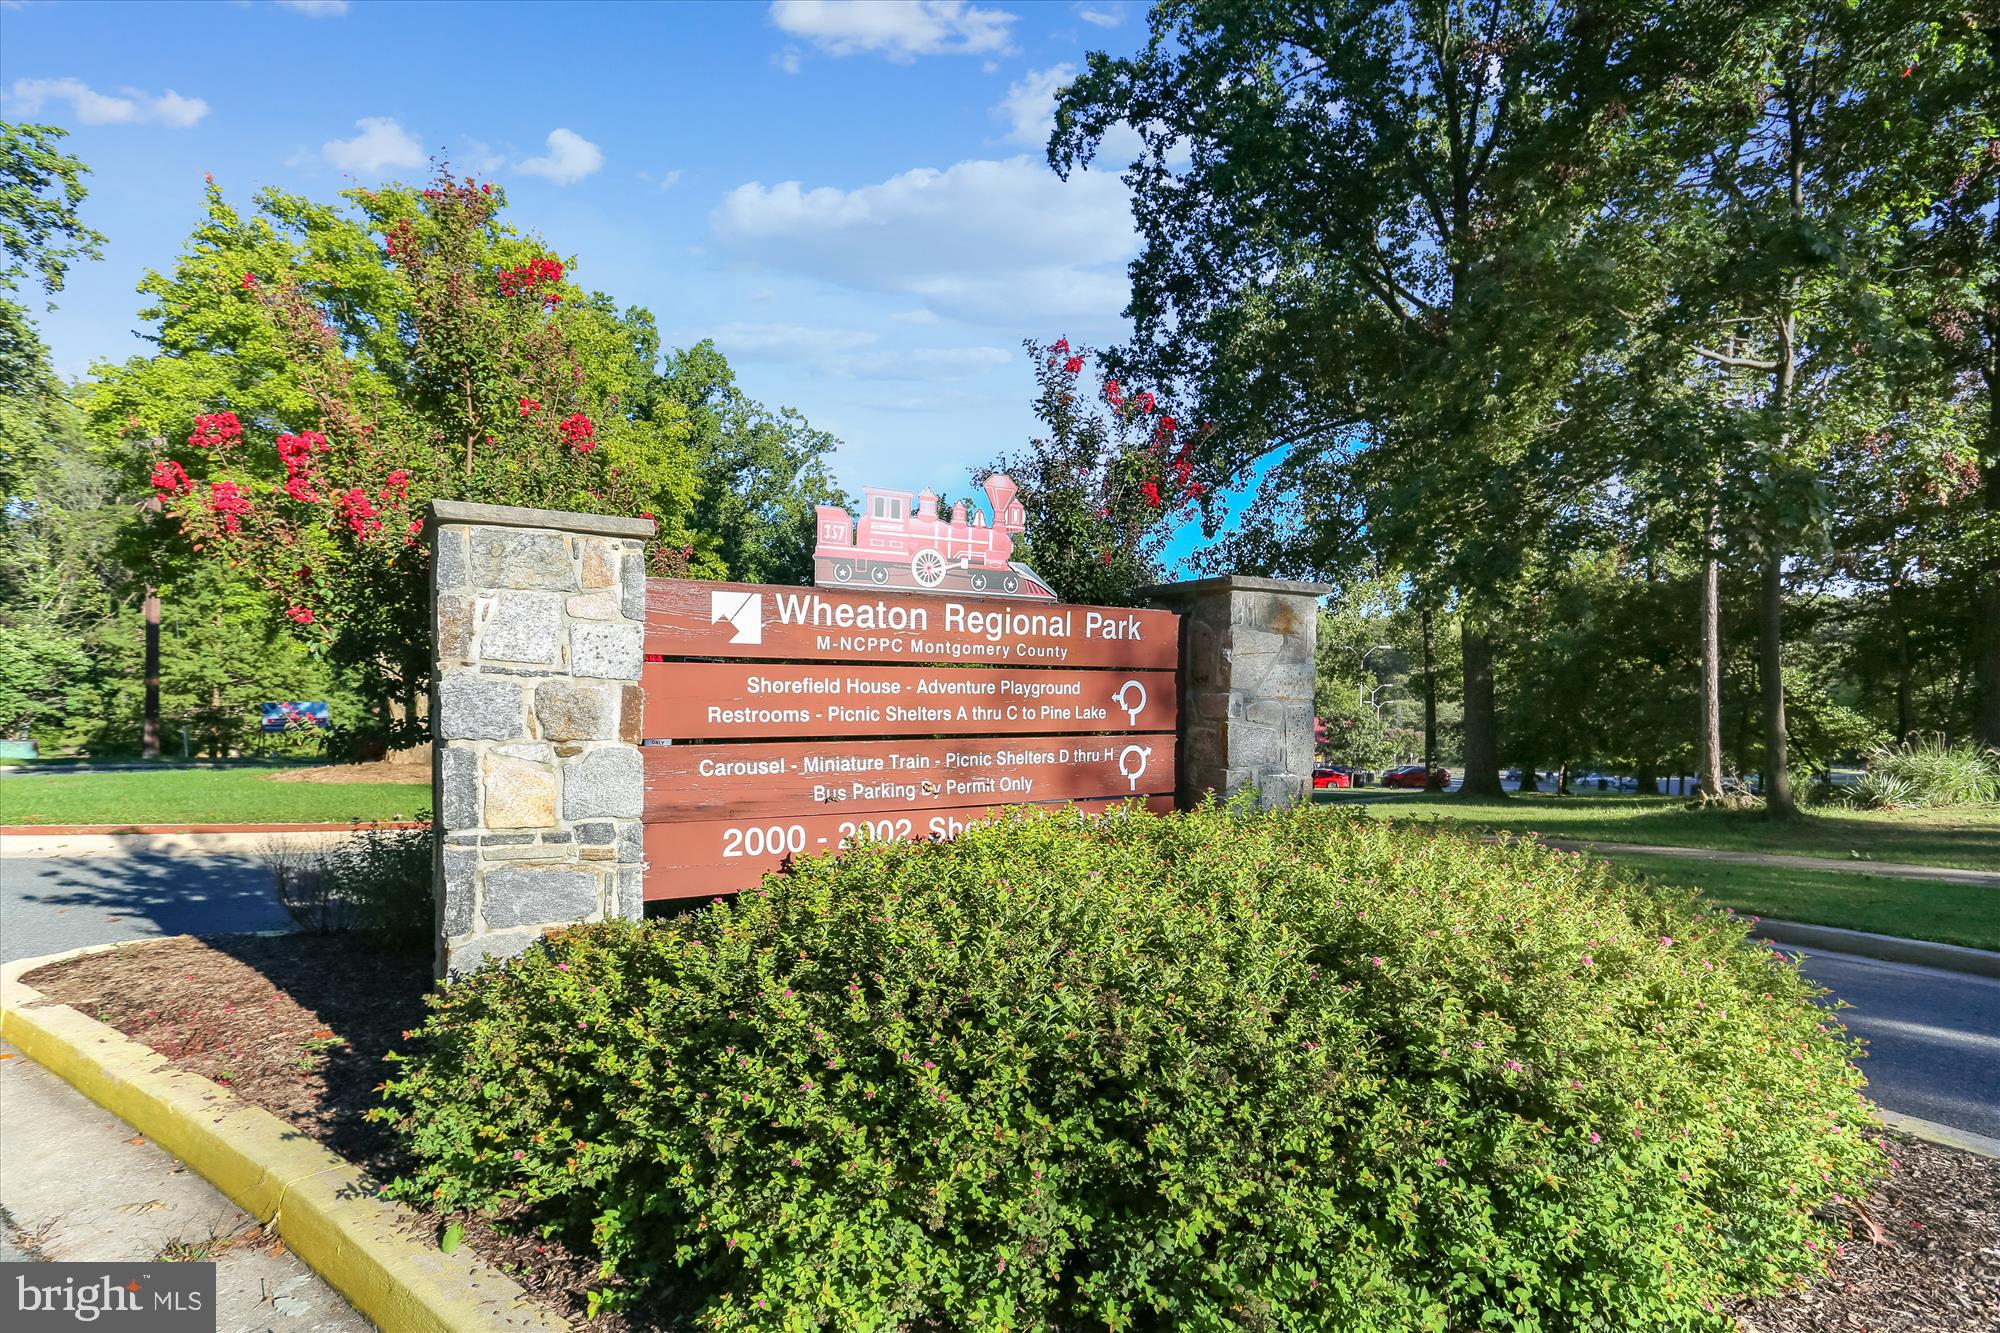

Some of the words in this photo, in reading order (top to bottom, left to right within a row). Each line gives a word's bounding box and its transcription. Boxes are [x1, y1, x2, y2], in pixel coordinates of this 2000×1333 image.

[775, 593, 928, 631] Wheaton
[945, 603, 1072, 641] Regional
[1086, 611, 1142, 641] Park
[816, 635, 903, 653] M-NCPPC
[910, 640, 1010, 659] Montgomery
[1016, 643, 1068, 661] County
[747, 676, 841, 694] Shorefield
[847, 678, 901, 694] House
[916, 679, 996, 695] Adventure
[1000, 680, 1081, 698] Playground
[708, 706, 810, 723] Restrooms
[828, 706, 880, 722] Picnic
[885, 706, 952, 721] Shelters
[956, 706, 968, 721] A
[972, 706, 1001, 721] thru
[1006, 706, 1018, 720] C
[1022, 707, 1036, 720] to
[1041, 706, 1071, 719] Pine
[1075, 706, 1107, 719] Lake
[699, 757, 785, 777] Carousel
[804, 755, 884, 773] Miniature
[889, 753, 930, 769] Train
[946, 752, 992, 767] Picnic
[996, 751, 1055, 765] Shelters
[1060, 749, 1069, 763] D
[1073, 749, 1100, 762] thru
[1104, 747, 1114, 761] H
[813, 784, 847, 802] Bus
[852, 782, 915, 801] Parking
[921, 780, 941, 799] By
[946, 778, 996, 795] Permit
[1000, 776, 1033, 793] Only
[722, 824, 806, 857] 2000
[837, 818, 913, 849] 2002
